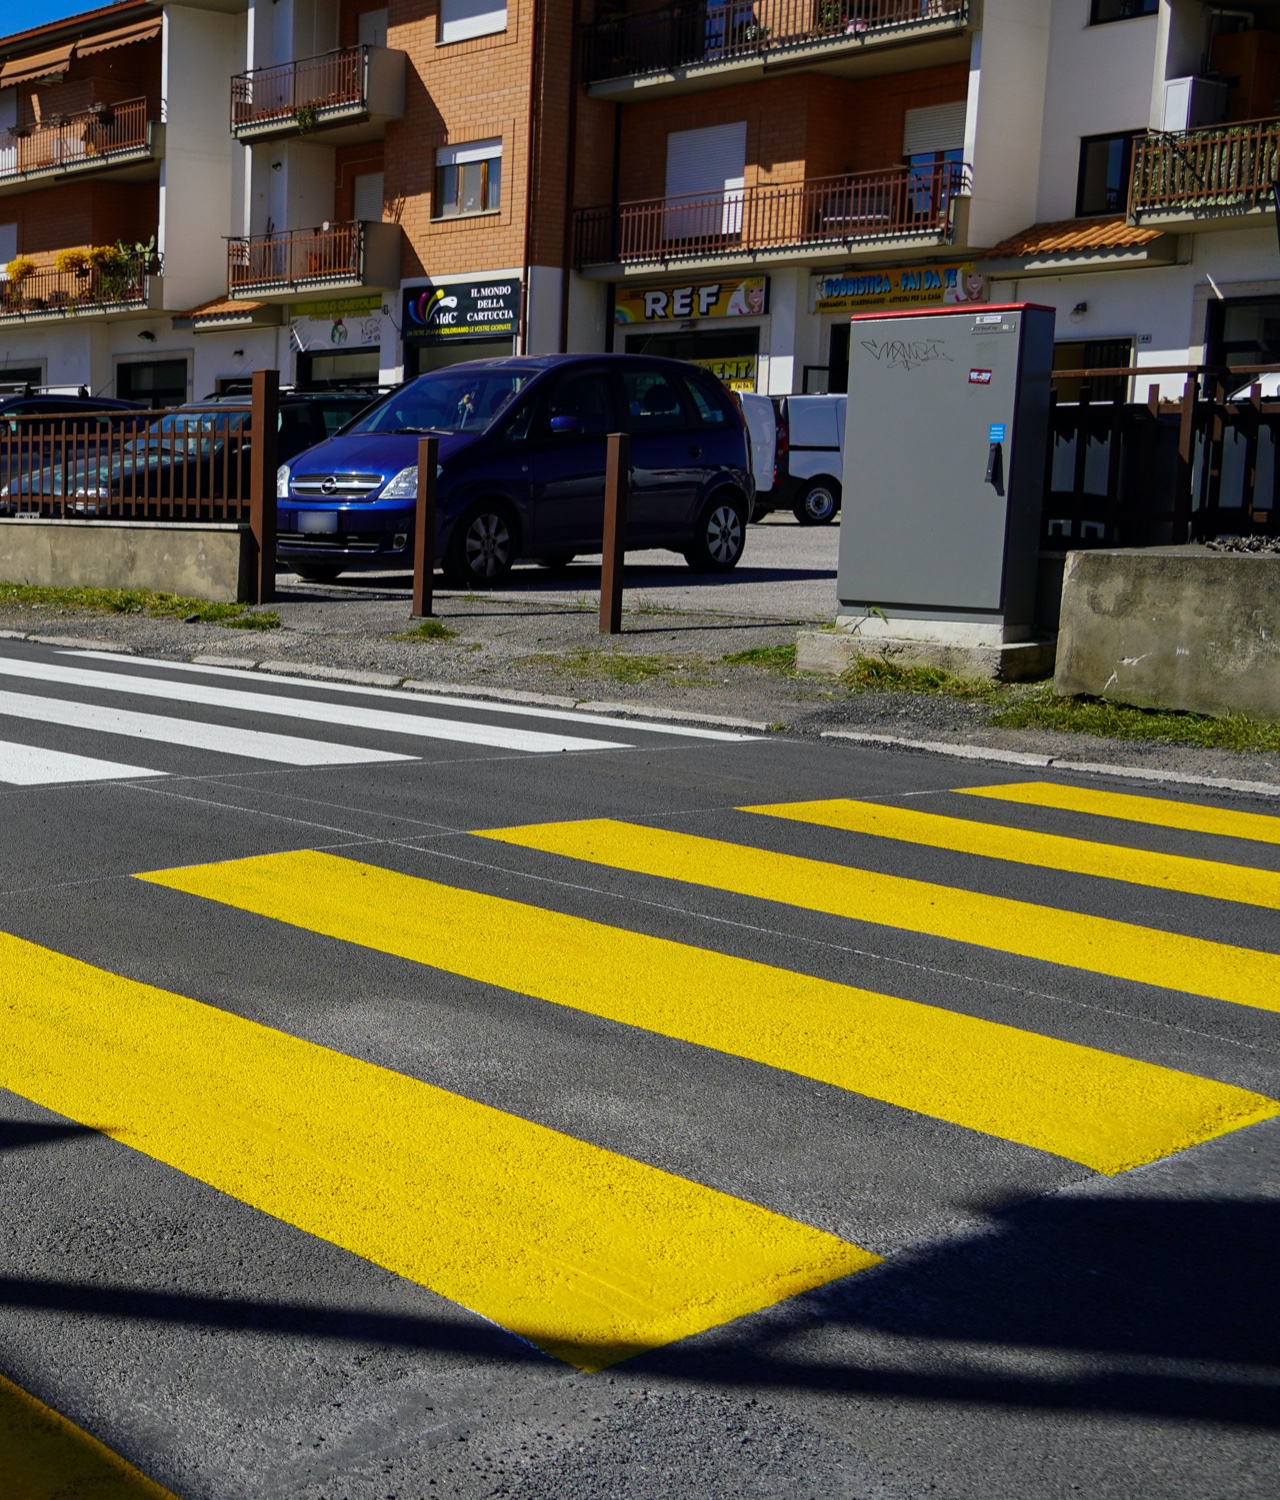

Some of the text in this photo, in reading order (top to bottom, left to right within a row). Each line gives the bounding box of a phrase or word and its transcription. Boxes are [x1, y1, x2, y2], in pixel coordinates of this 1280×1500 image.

[901, 272, 921, 292] FAI
[924, 269, 941, 289] DA
[944, 268, 958, 289] TE
[471, 286, 511, 297] IL MONDO
[477, 299, 504, 309] DELLA
[644, 284, 720, 318] REF
[889, 296, 910, 304] ARTICOLI
[928, 293, 942, 301] CASA
[467, 310, 513, 321] CARTUCCIA
[441, 326, 469, 335] COLORIAMO
[474, 324, 490, 332] VOSTRE
